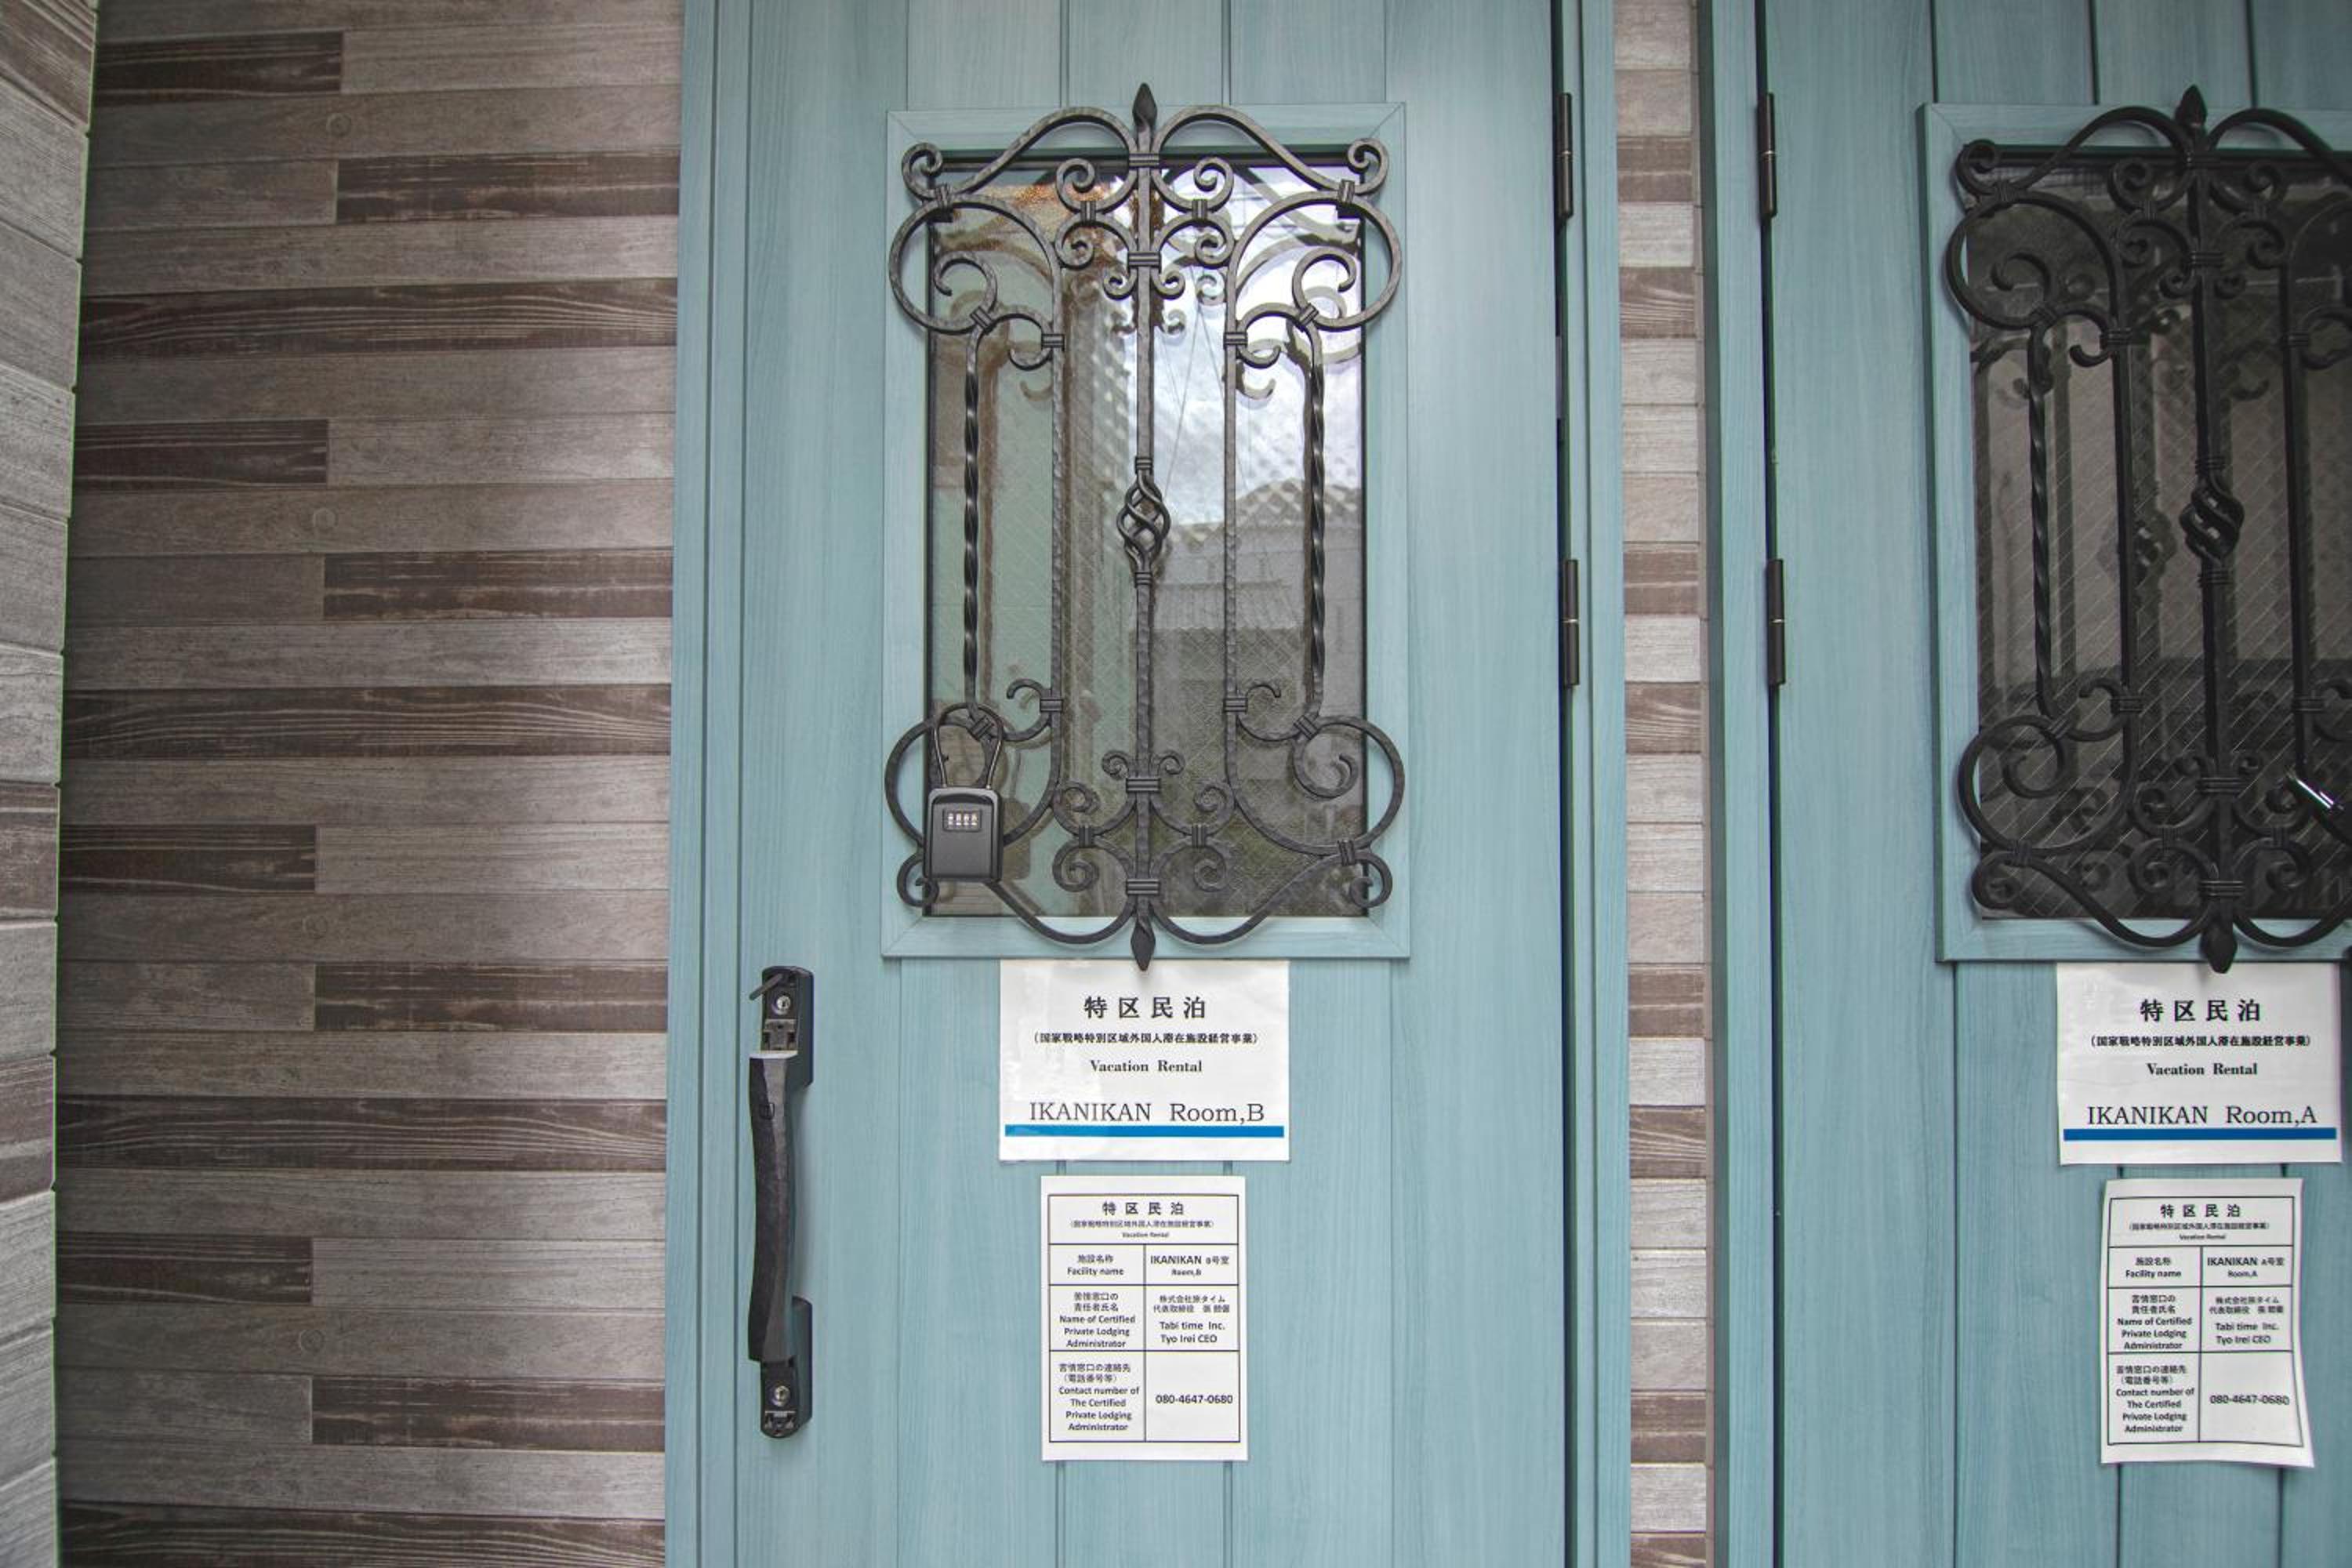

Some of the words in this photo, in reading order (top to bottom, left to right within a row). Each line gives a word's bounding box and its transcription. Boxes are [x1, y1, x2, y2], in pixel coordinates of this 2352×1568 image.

[1084, 996, 1206, 1019] 特区民泊
[2140, 999, 2260, 1022] 特区民泊
[1091, 1060, 1149, 1073] Vacation
[1158, 1060, 1203, 1073] Rental
[2147, 1063, 2205, 1076] Vacation
[2212, 1063, 2258, 1076] Rental
[1029, 1102, 1151, 1121] IKANIKAN
[1170, 1102, 1265, 1124] Room,B
[2087, 1106, 2208, 1125] IKANIKAN
[2226, 1106, 2317, 1127] Room,A
[1102, 1201, 1184, 1215] 特区民泊
[2160, 1204, 2241, 1217] 特区民泊
[1150, 1255, 1202, 1264] IKANIKAN
[2207, 1258, 2258, 1266] IKANIKAN
[1067, 1267, 1098, 1276] Facility
[2125, 1269, 2155, 1278] Facility
[1087, 1315, 1097, 1323] of
[1098, 1315, 1135, 1323] Certified
[1160, 1321, 1179, 1330] Tabi
[1064, 1327, 1094, 1336] Private
[1097, 1327, 1130, 1337] Lodging
[2154, 1330, 2187, 1339] Lodging
[1161, 1334, 1178, 1344] Tyo
[1197, 1334, 1217, 1343] CEO
[2216, 1336, 2233, 1345] Tyo
[2151, 1388, 2183, 1396] number
[1088, 1399, 1127, 1407] Certified
[1156, 1395, 1233, 1404] 080-4647-0680
[2210, 1396, 2290, 1405] 080-4647-0680
[1098, 1411, 1132, 1421] Lodging
[2154, 1413, 2187, 1421] Lodging
